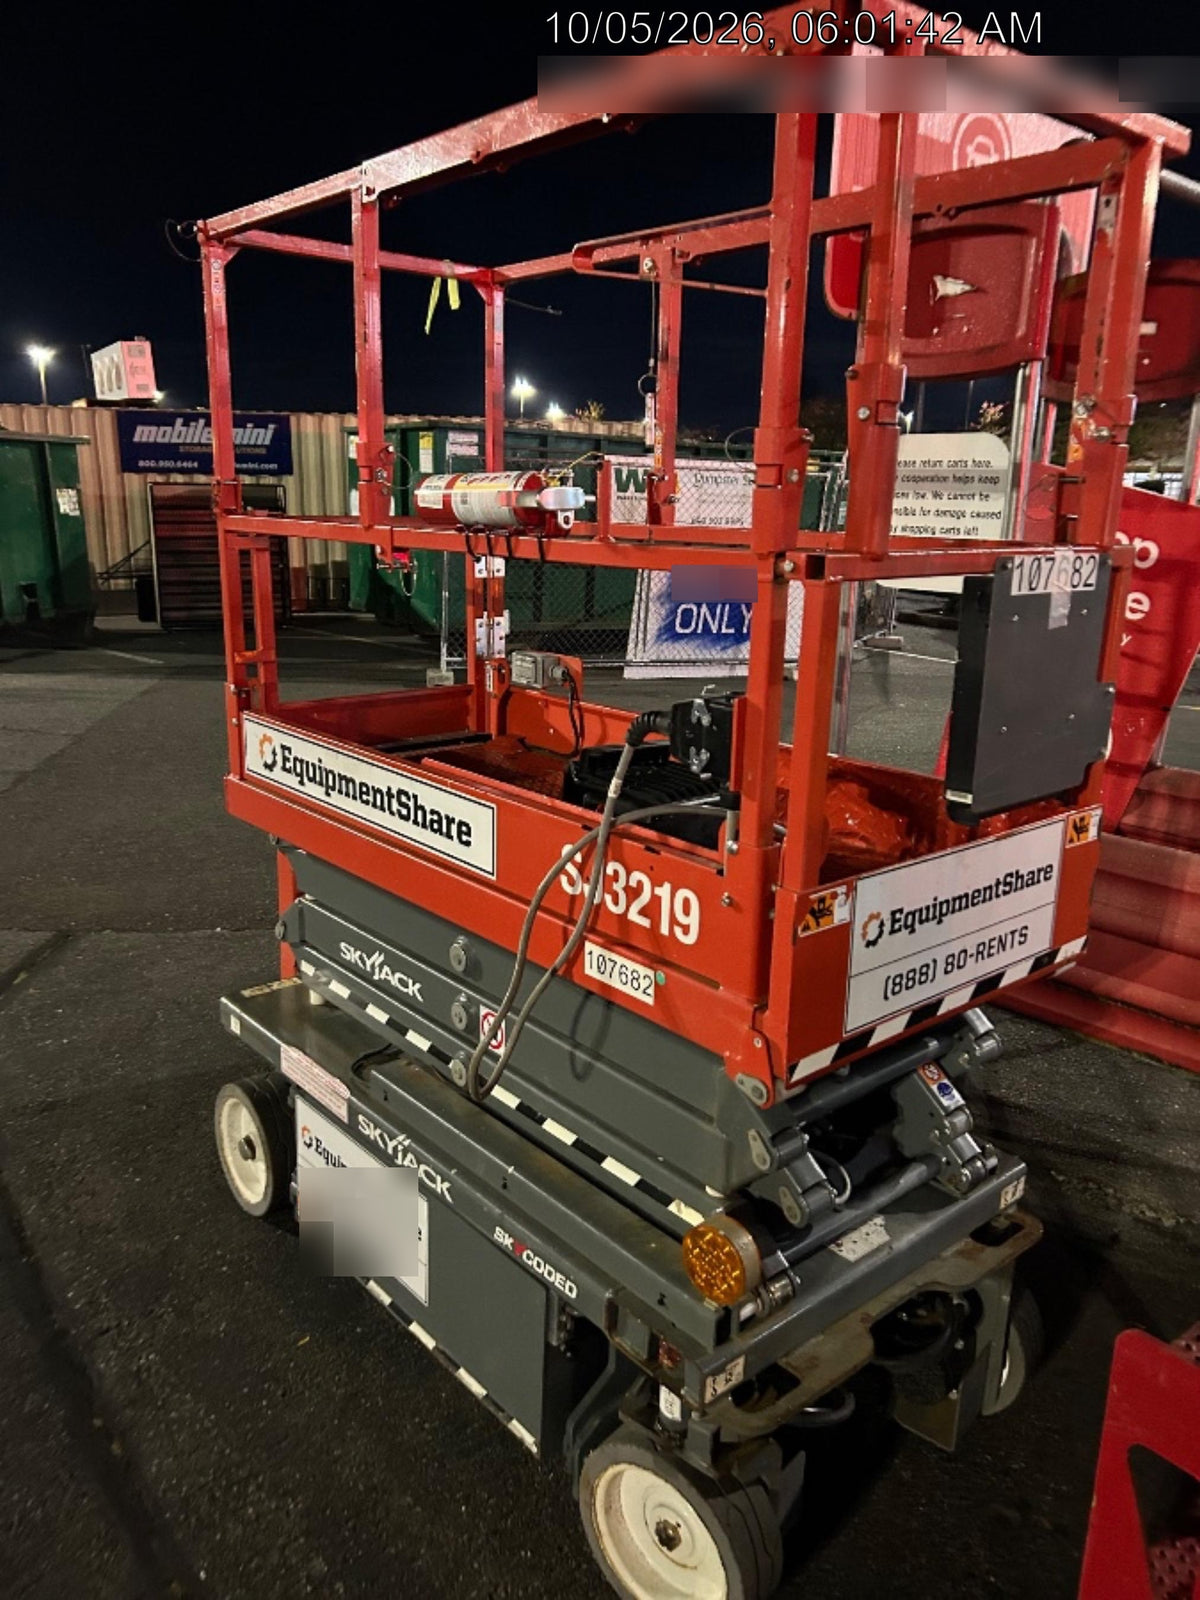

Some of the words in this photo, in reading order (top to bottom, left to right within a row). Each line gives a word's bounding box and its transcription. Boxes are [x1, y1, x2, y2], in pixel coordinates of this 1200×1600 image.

[133, 418, 213, 443] mobile
[901, 473, 949, 484] cooperation
[952, 473, 975, 485] helps
[978, 474, 1000, 485] keep
[919, 459, 943, 468] return
[947, 459, 968, 468] carts
[971, 458, 993, 468] here.
[947, 492, 975, 500] cannot
[978, 491, 990, 501] be
[919, 506, 931, 516] for
[934, 508, 966, 519] damage
[970, 510, 1001, 519] caused
[940, 526, 961, 536] carts
[1014, 555, 1097, 592] 107682
[674, 602, 753, 634] ONLY
[279, 742, 473, 848] EquipmentShare
[888, 863, 1054, 936] EquipmentShare
[340, 941, 424, 1003] SKYJACK
[586, 950, 653, 997] 107682
[883, 957, 938, 1001] (888)
[943, 924, 1029, 976] 80-RENTS
